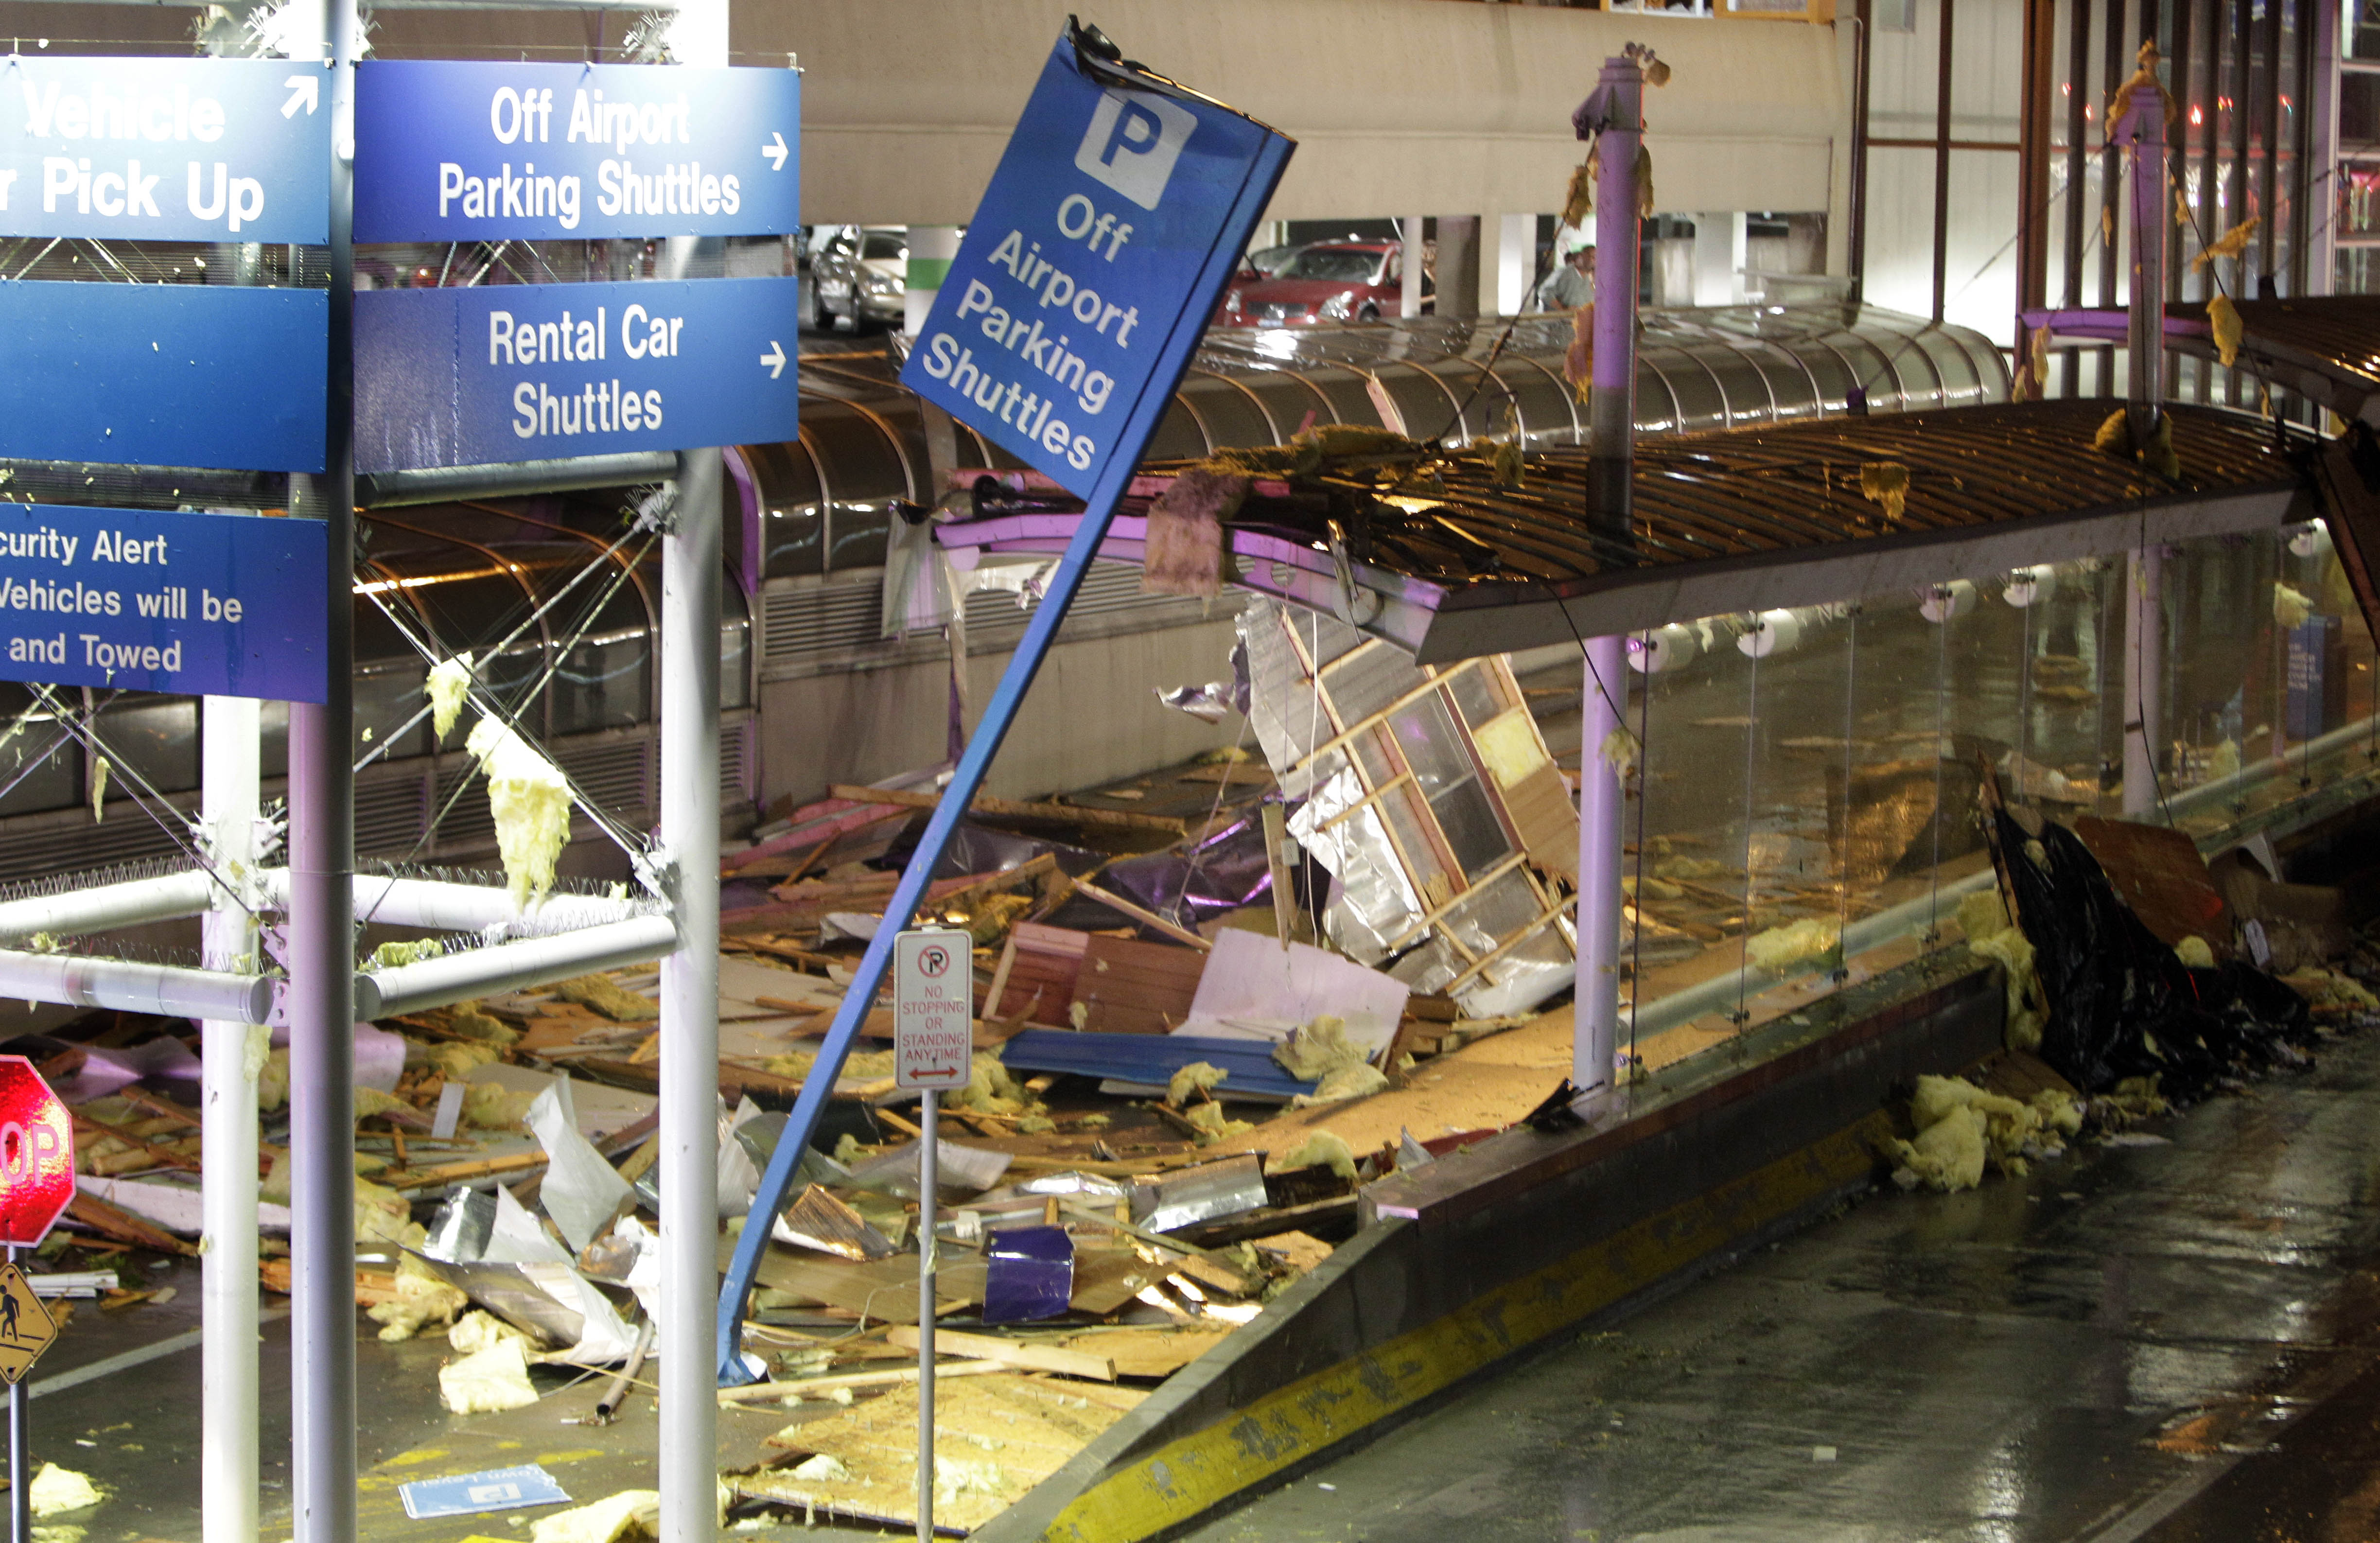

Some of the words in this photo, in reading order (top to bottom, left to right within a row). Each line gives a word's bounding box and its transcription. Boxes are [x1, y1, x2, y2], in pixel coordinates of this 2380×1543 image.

[22, 81, 225, 142] Vehicle
[491, 87, 553, 144] Off
[568, 89, 690, 155] Airport
[43, 156, 160, 217] Pick
[187, 161, 264, 232] Up
[439, 162, 580, 229] Parking
[597, 159, 740, 216] Shuttles
[1057, 193, 1134, 263] Off
[987, 229, 1138, 349] Airport
[490, 307, 606, 365] Rental
[622, 304, 683, 359] Car
[956, 278, 1115, 415] Parking
[512, 379, 663, 439] Shuttles
[923, 333, 1095, 471] Shuttles
[91, 529, 167, 565] Alert
[0, 577, 121, 615] Vehicles
[136, 586, 187, 620] will
[202, 589, 243, 623] be
[9, 632, 66, 665] and
[79, 634, 181, 672] Towed
[903, 1001, 965, 1015] STOPPING
[925, 985, 943, 998] NO
[903, 1032, 965, 1047] STANDING
[926, 1017, 943, 1030] OR
[0, 1121, 59, 1186] OP
